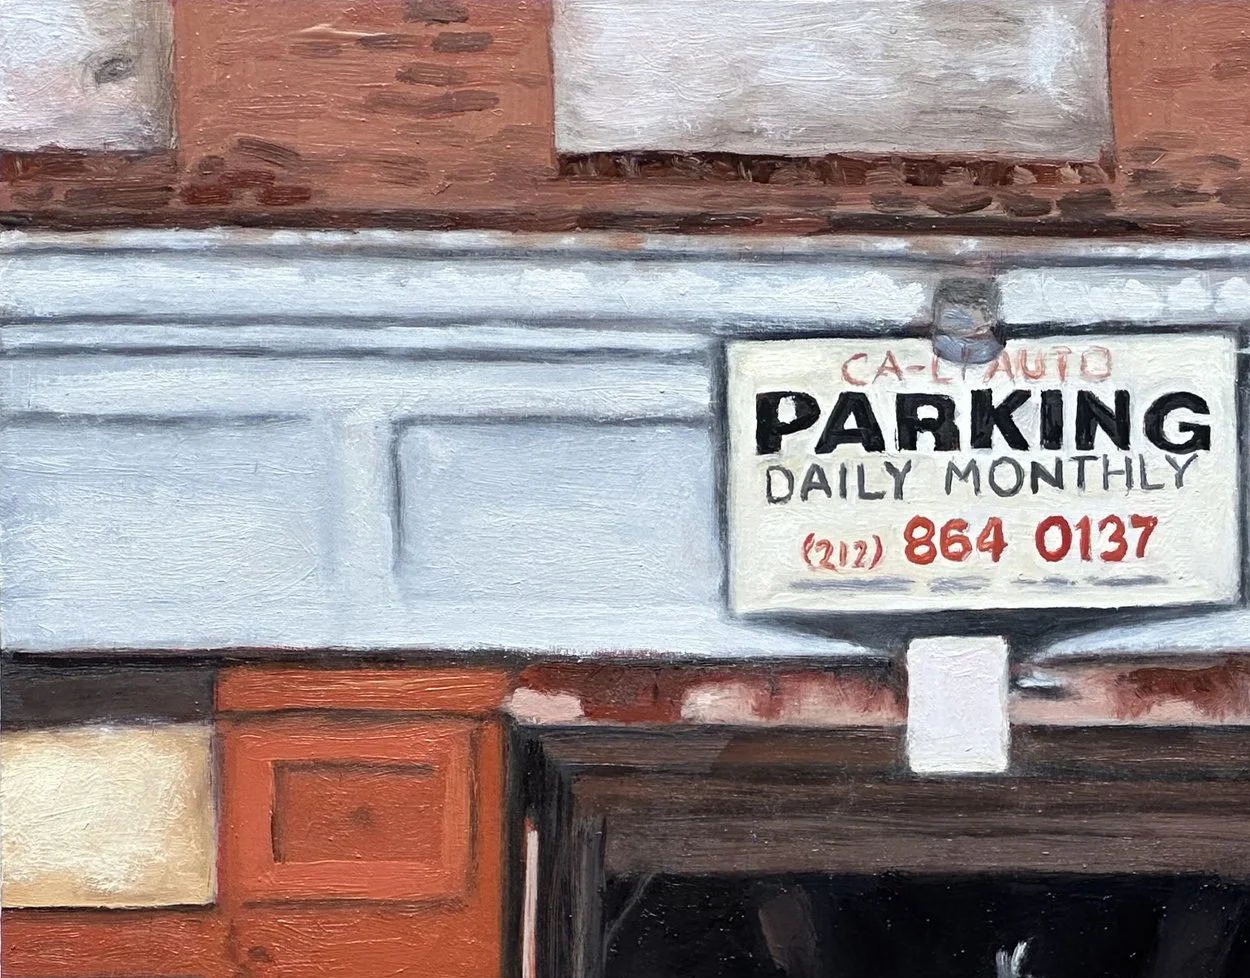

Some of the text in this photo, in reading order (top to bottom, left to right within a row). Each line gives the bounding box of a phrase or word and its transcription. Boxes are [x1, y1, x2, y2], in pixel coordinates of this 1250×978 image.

[983, 345, 1113, 383] AUTO
[755, 388, 1212, 455] PARKING
[764, 453, 1199, 504] DAILY MONTHLY
[802, 513, 1158, 571] (212) 864 0137
